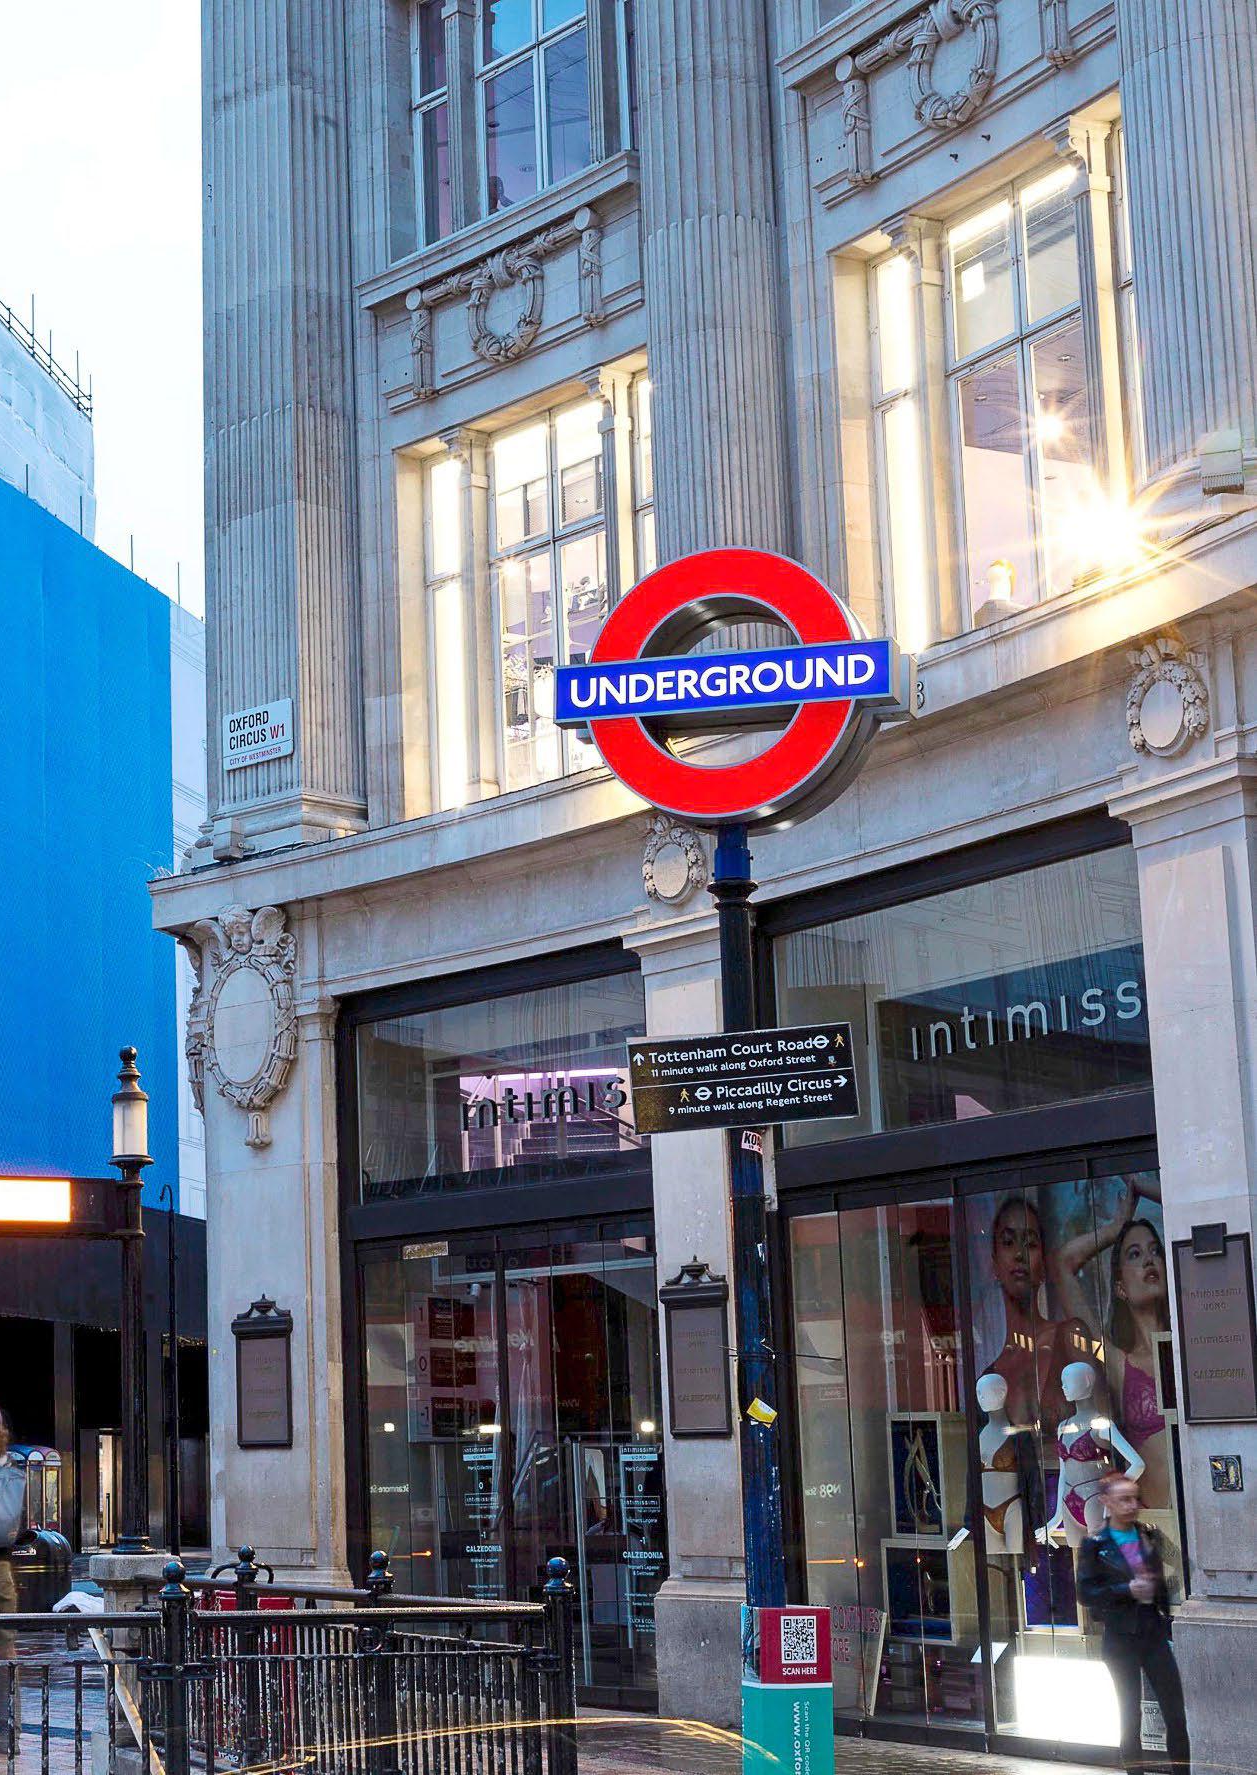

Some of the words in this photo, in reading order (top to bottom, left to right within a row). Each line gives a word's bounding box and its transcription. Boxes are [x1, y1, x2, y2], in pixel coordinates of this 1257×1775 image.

[569, 653, 876, 709] UNDERGROUND
[229, 710, 269, 733] OXFORD
[229, 728, 267, 750] CIRCUS
[270, 723, 285, 739] W1
[230, 757, 240, 766] CITY
[249, 746, 282, 761] WESTMINSTER
[649, 1047, 727, 1065] Tottenham
[731, 1041, 773, 1057] Court
[778, 1037, 813, 1051] Road
[651, 1069, 659, 1077] 11
[661, 1066, 694, 1077] minute
[696, 1062, 719, 1073] walk
[721, 1060, 747, 1071] along
[749, 1057, 783, 1068] Oxford
[786, 1054, 816, 1065] Street
[716, 1081, 782, 1099] Piccadilly
[787, 1077, 832, 1092] Circus
[668, 1106, 675, 1115] 9
[678, 1103, 711, 1114] minute
[713, 1101, 736, 1111] walk
[738, 1098, 763, 1111] along
[766, 1096, 801, 1108] Regent
[803, 1093, 833, 1103] Street
[465, 1545, 503, 1553] CALZEDONIA
[622, 1551, 664, 1559] CALZEDONIA
[782, 1667, 800, 1676] SCAN
[801, 1666, 817, 1675] HERE
[804, 1739, 811, 1753] QR
